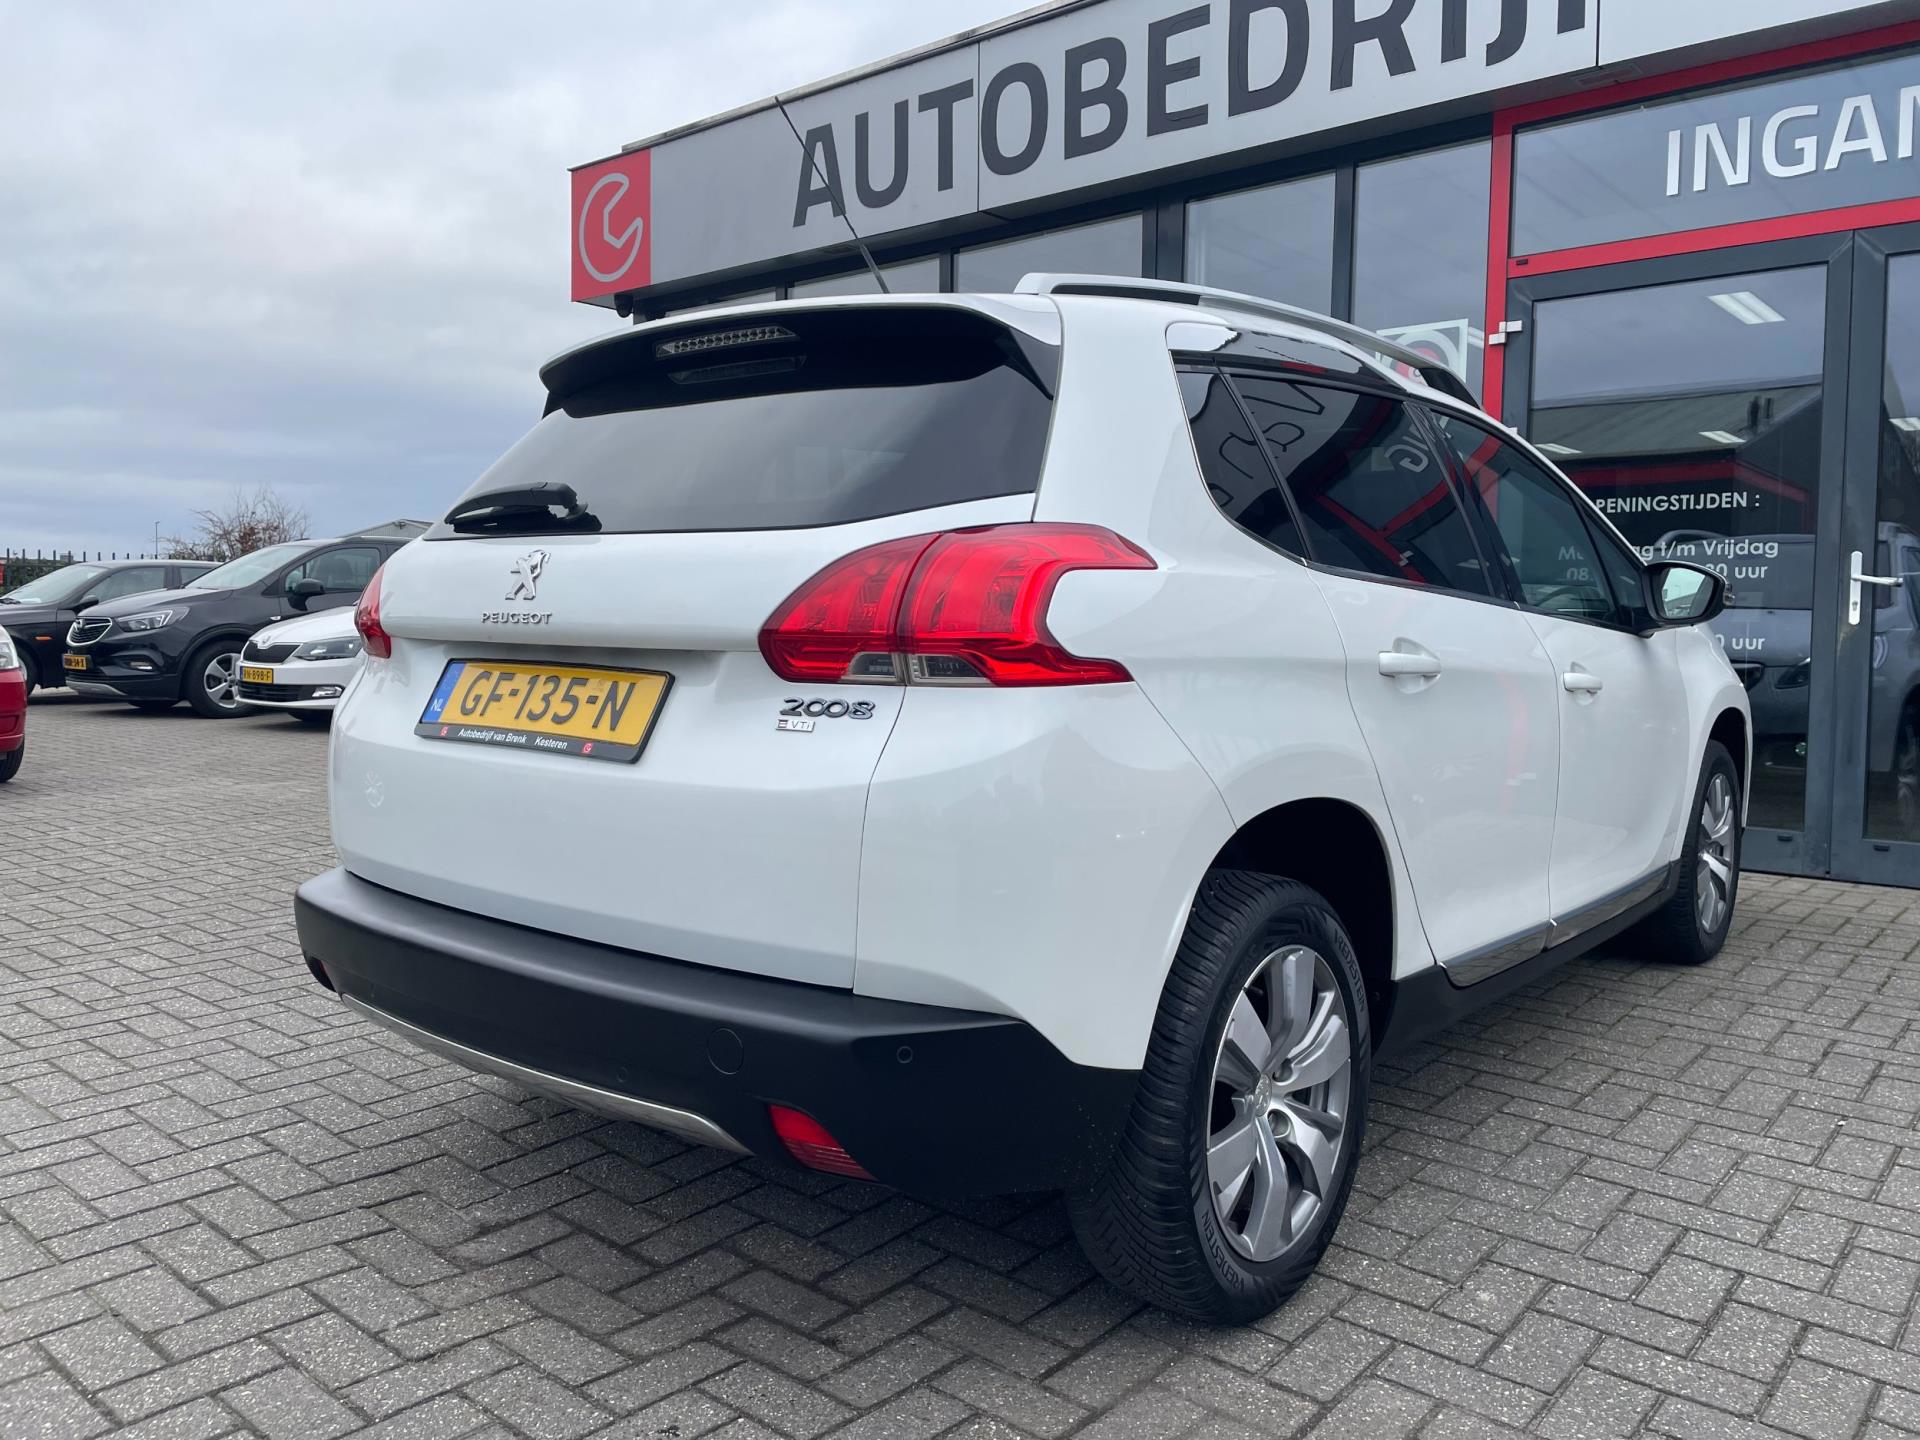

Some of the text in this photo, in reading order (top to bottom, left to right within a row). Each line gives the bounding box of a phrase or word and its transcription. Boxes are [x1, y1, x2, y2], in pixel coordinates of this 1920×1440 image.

[793, 0, 1586, 228] AUTOBEDRIJ
[1595, 491, 1748, 514] PENINGSTIJDEN
[1660, 540, 1696, 559] t/m
[1702, 538, 1779, 559] Vrijdag
[1733, 563, 1769, 580] uur
[480, 611, 553, 625] PEUGEOT
[1731, 634, 1766, 651] uur
[431, 697, 444, 712] NL
[459, 670, 638, 732] GF-135-N
[779, 696, 876, 721] 2008
[457, 727, 493, 743] Autobedrijf
[493, 733, 506, 742] van
[534, 735, 569, 750] Kesteren
